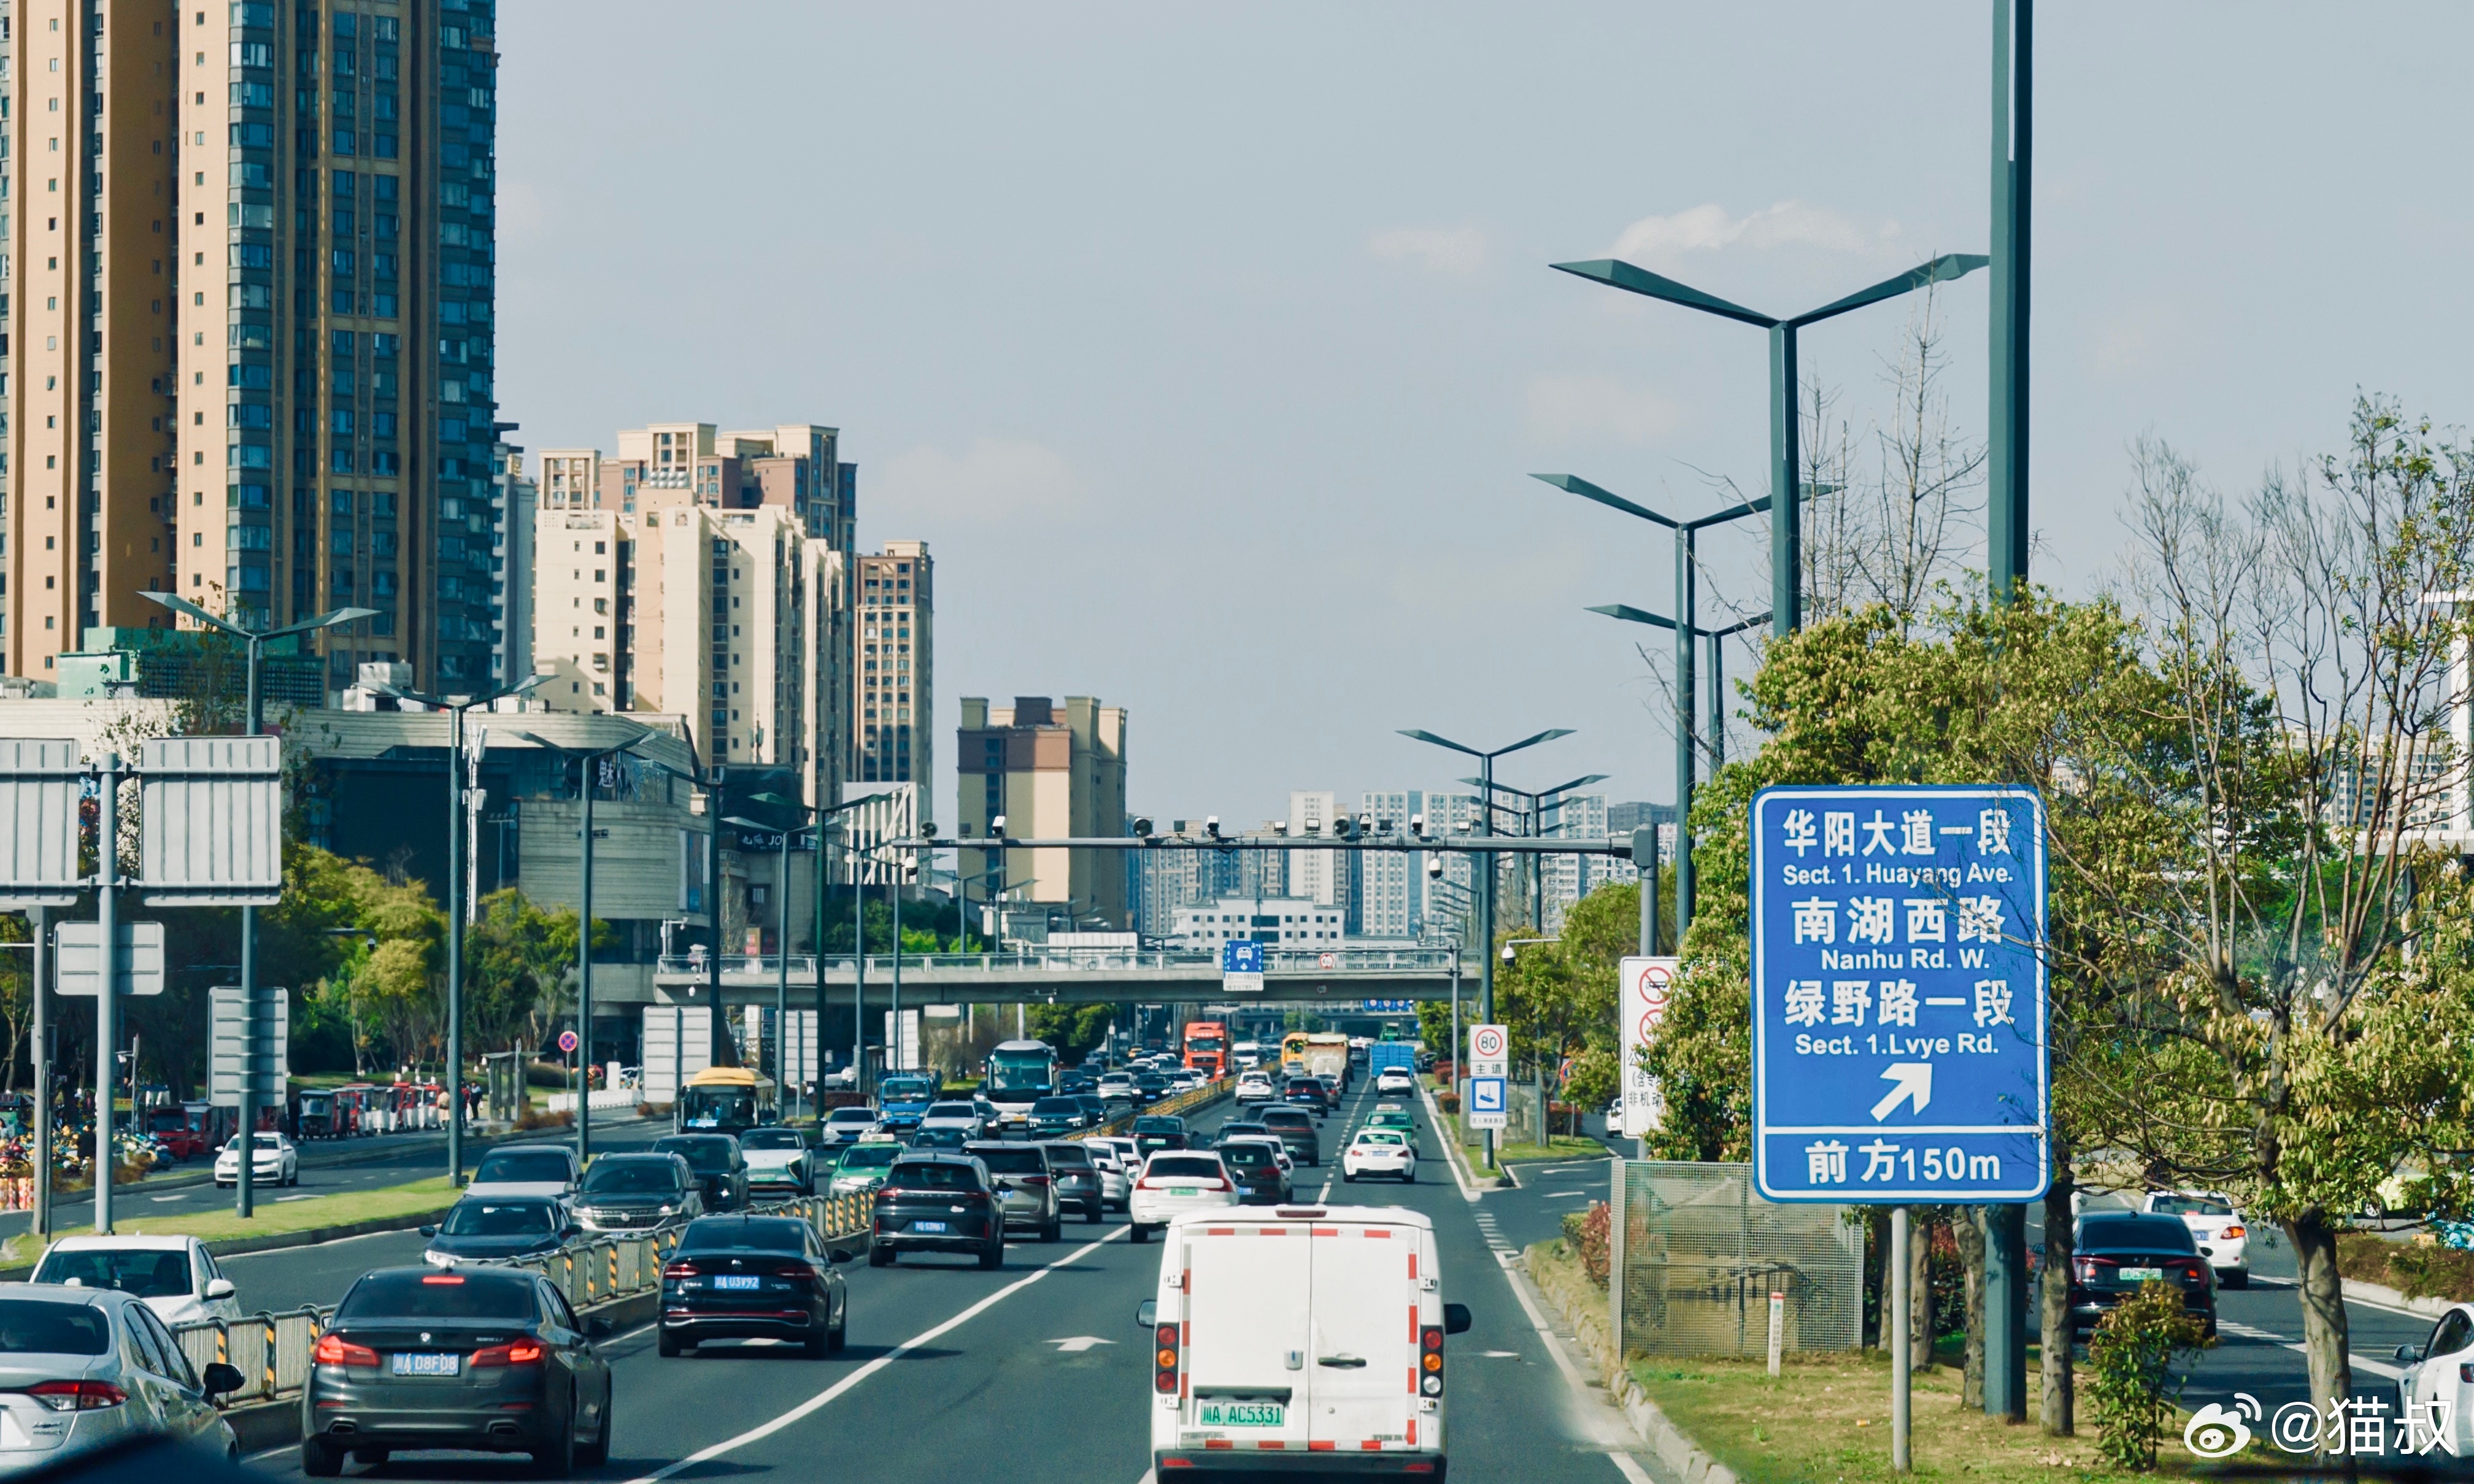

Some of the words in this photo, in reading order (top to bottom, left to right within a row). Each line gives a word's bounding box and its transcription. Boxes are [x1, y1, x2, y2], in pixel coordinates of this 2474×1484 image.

[1783, 809, 2011, 857] 华阳大道一段
[1784, 864, 1835, 885] Sect.
[1842, 864, 1860, 883] 1.
[1867, 863, 1961, 888] Huayang
[1967, 863, 2013, 883] Ave.
[1792, 895, 2005, 945] 南湖西路
[1822, 949, 1903, 970] Nanhu
[1911, 948, 1951, 969] Rd.
[1959, 948, 1989, 969] W.
[1784, 978, 2016, 1028] 绿野路一段
[1481, 1036, 1497, 1049] 80
[1795, 1034, 1858, 1055] Sect.
[1958, 1033, 1998, 1053] Rd.
[1476, 1064, 1502, 1074] 主道
[1805, 1139, 2000, 1184] 前方150m
